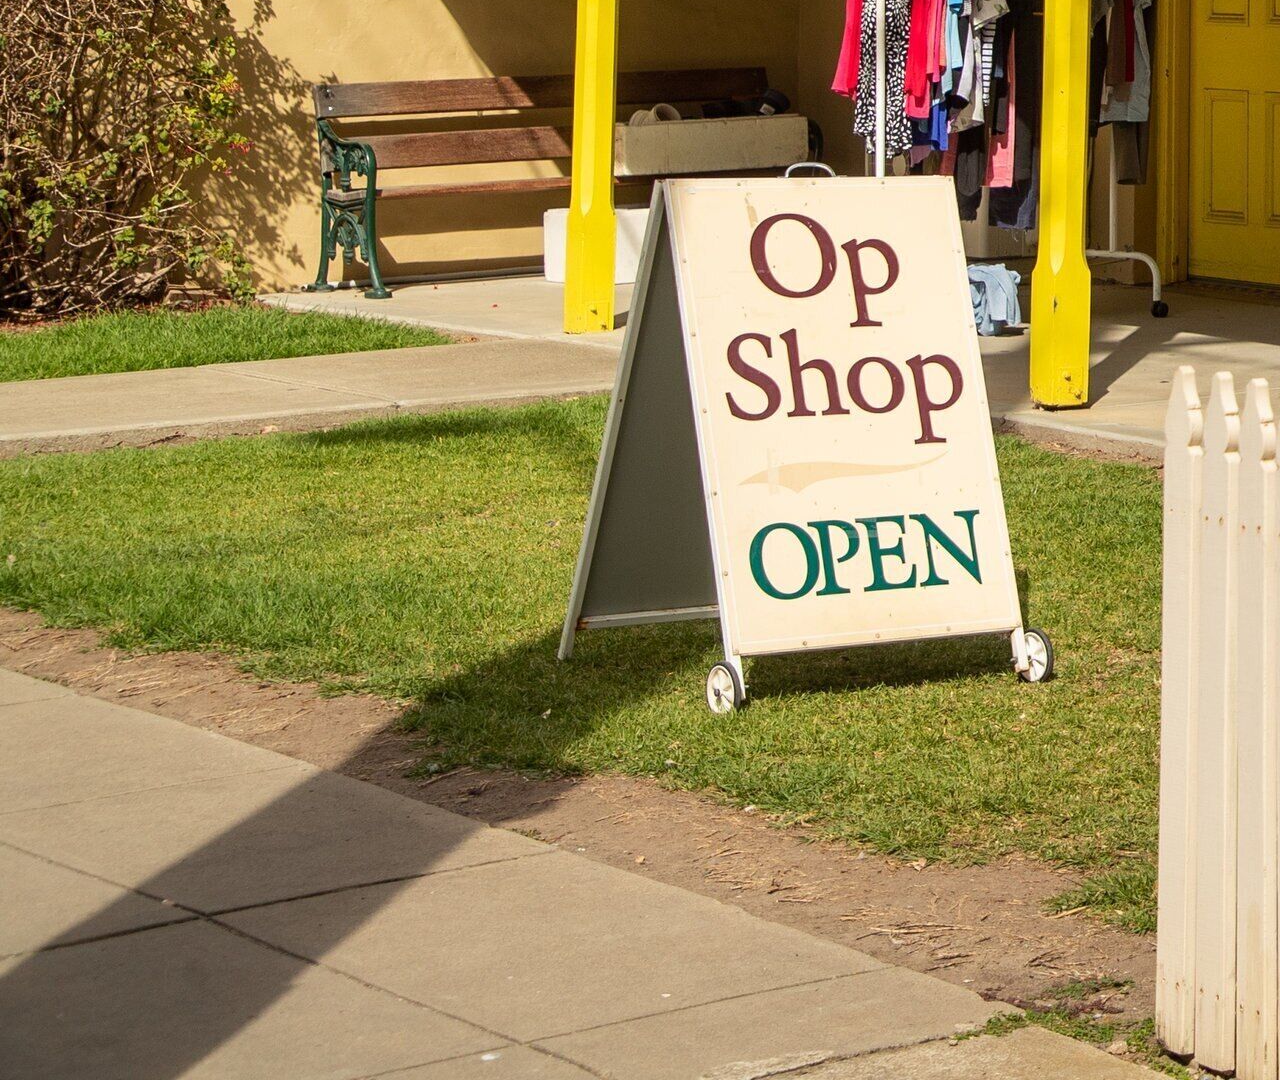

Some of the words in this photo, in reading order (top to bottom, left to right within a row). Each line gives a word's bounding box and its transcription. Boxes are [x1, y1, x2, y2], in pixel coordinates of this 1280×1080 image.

[750, 213, 900, 328] Op
[725, 328, 964, 445] Shop
[748, 508, 984, 601] OPEN
